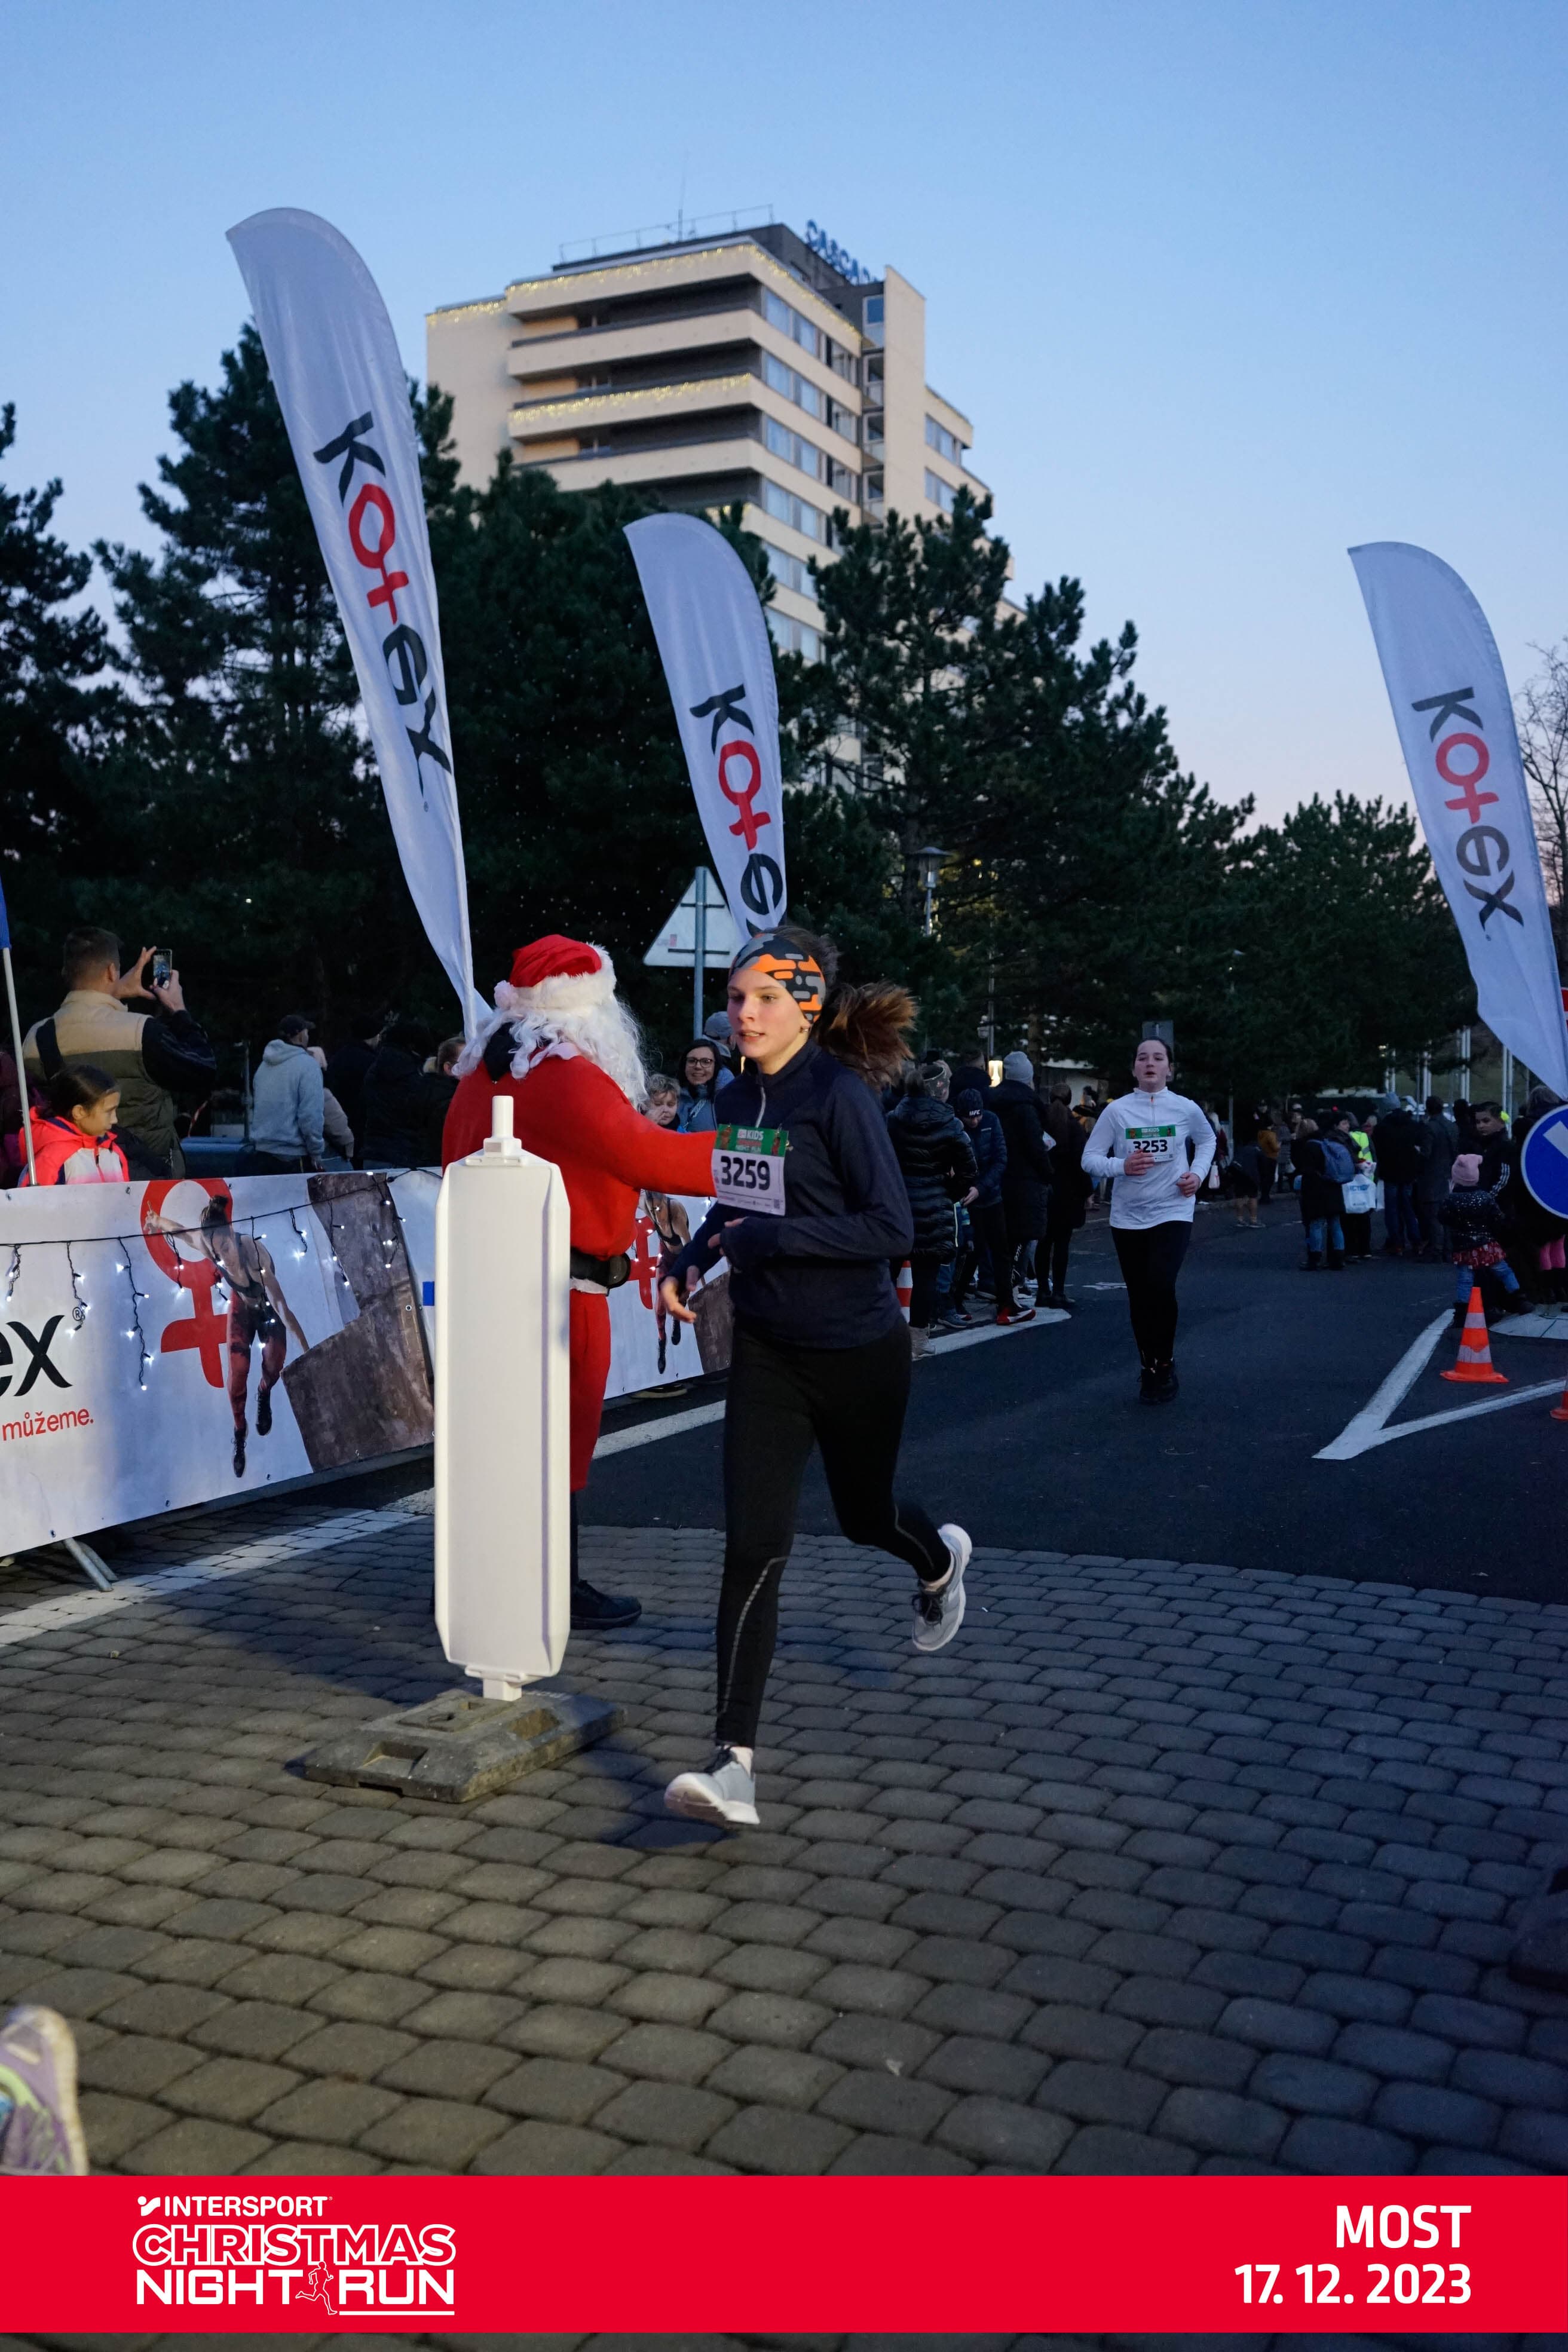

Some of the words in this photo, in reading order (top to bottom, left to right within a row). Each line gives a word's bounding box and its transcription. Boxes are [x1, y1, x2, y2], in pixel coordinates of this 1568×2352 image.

[690, 684, 787, 938] Kote
[1411, 687, 1524, 931] Kotex
[747, 1130, 764, 1141] KIDS
[1133, 1140, 1168, 1153] 3253
[721, 1156, 770, 1190] 3259
[2, 1408, 94, 1441] můžeme.
